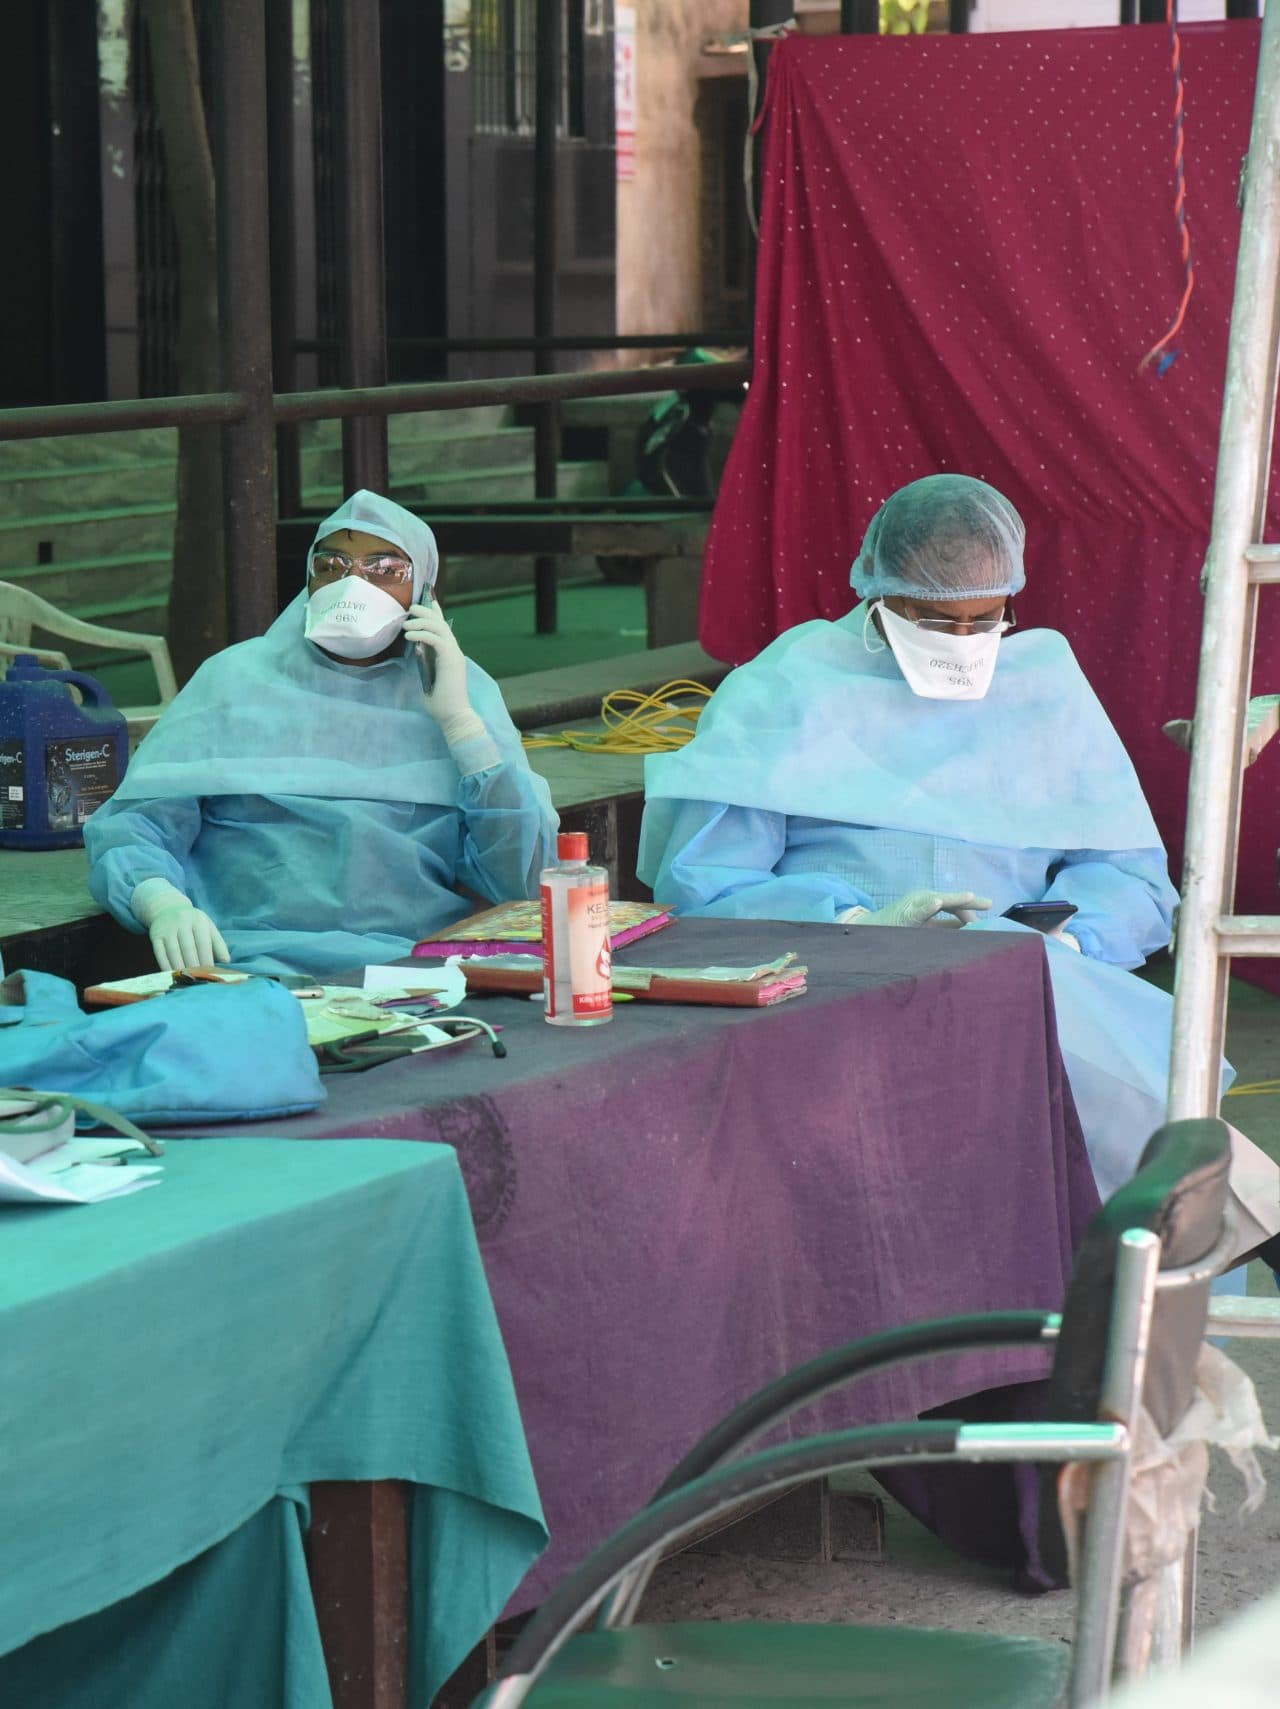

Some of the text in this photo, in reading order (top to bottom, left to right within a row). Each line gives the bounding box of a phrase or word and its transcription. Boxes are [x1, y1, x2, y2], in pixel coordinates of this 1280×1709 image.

[335, 613, 358, 623] N95
[948, 675, 974, 687] N95
[65, 743, 110, 762] Sterigen-C
